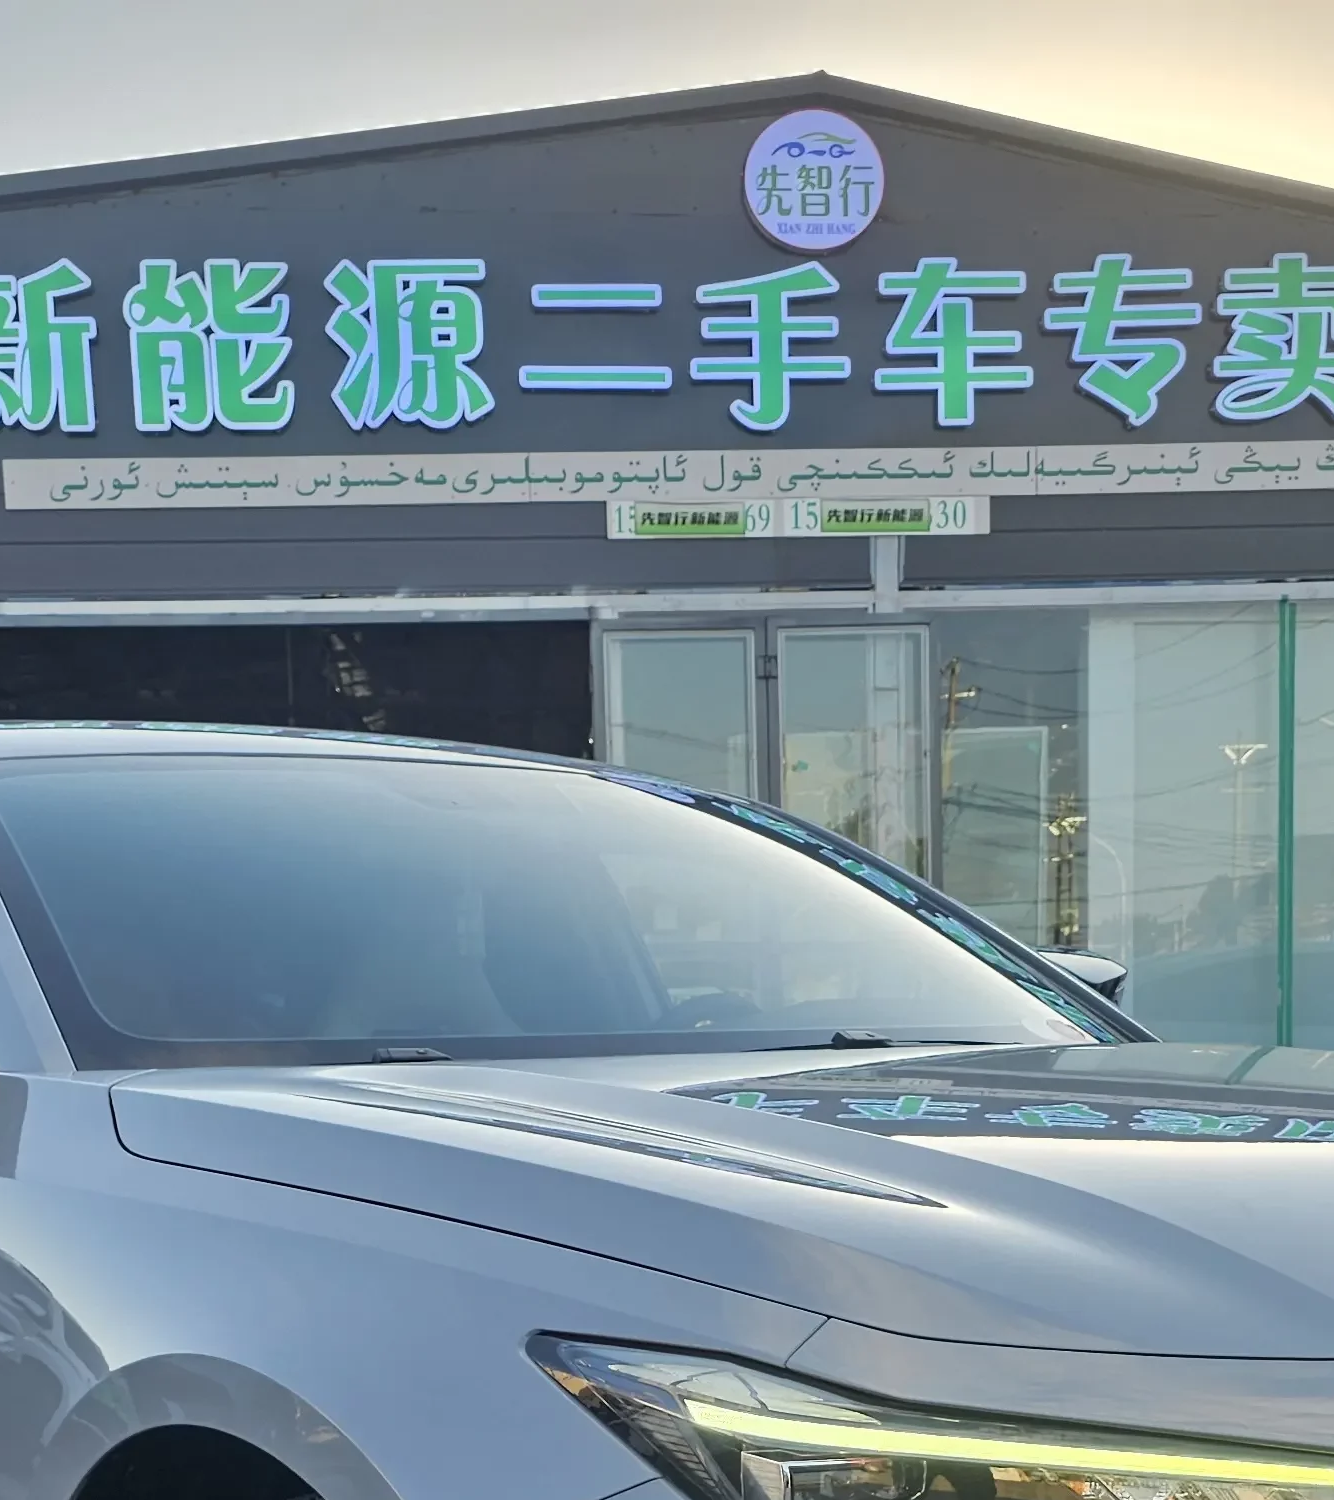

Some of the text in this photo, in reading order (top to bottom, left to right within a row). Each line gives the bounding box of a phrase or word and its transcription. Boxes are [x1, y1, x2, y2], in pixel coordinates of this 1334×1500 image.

[756, 164, 875, 217] 先智行
[777, 222, 856, 235] XIAN ZHI HANG
[703, 454, 762, 493] قول
[791, 501, 818, 530] 15
